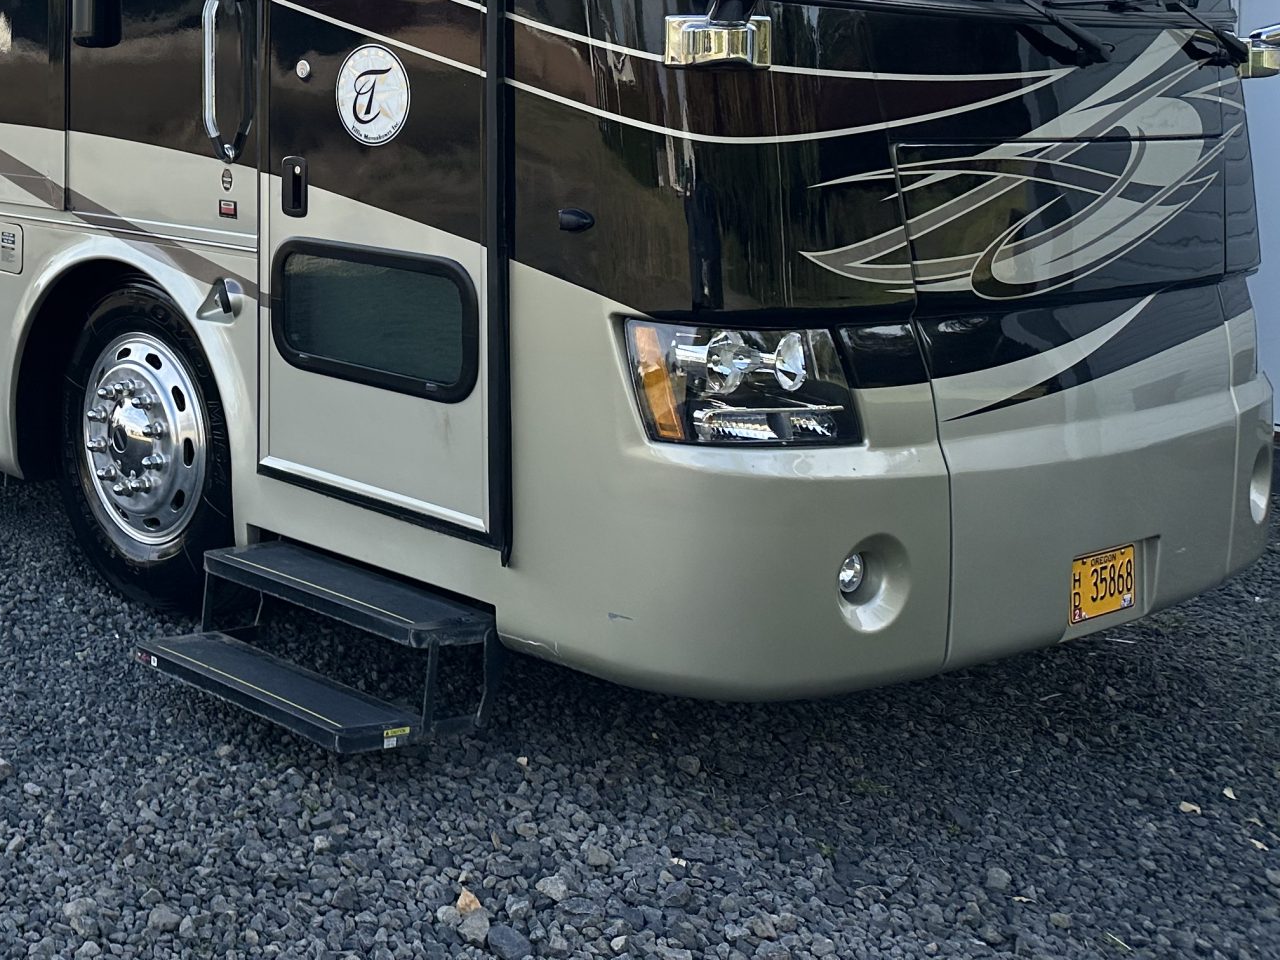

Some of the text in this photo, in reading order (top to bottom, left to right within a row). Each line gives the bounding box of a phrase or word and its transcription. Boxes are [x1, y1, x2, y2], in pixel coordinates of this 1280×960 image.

[127, 297, 210, 378] TOYO
[1090, 553, 1117, 567] OREGON
[1090, 558, 1133, 603] 35868
